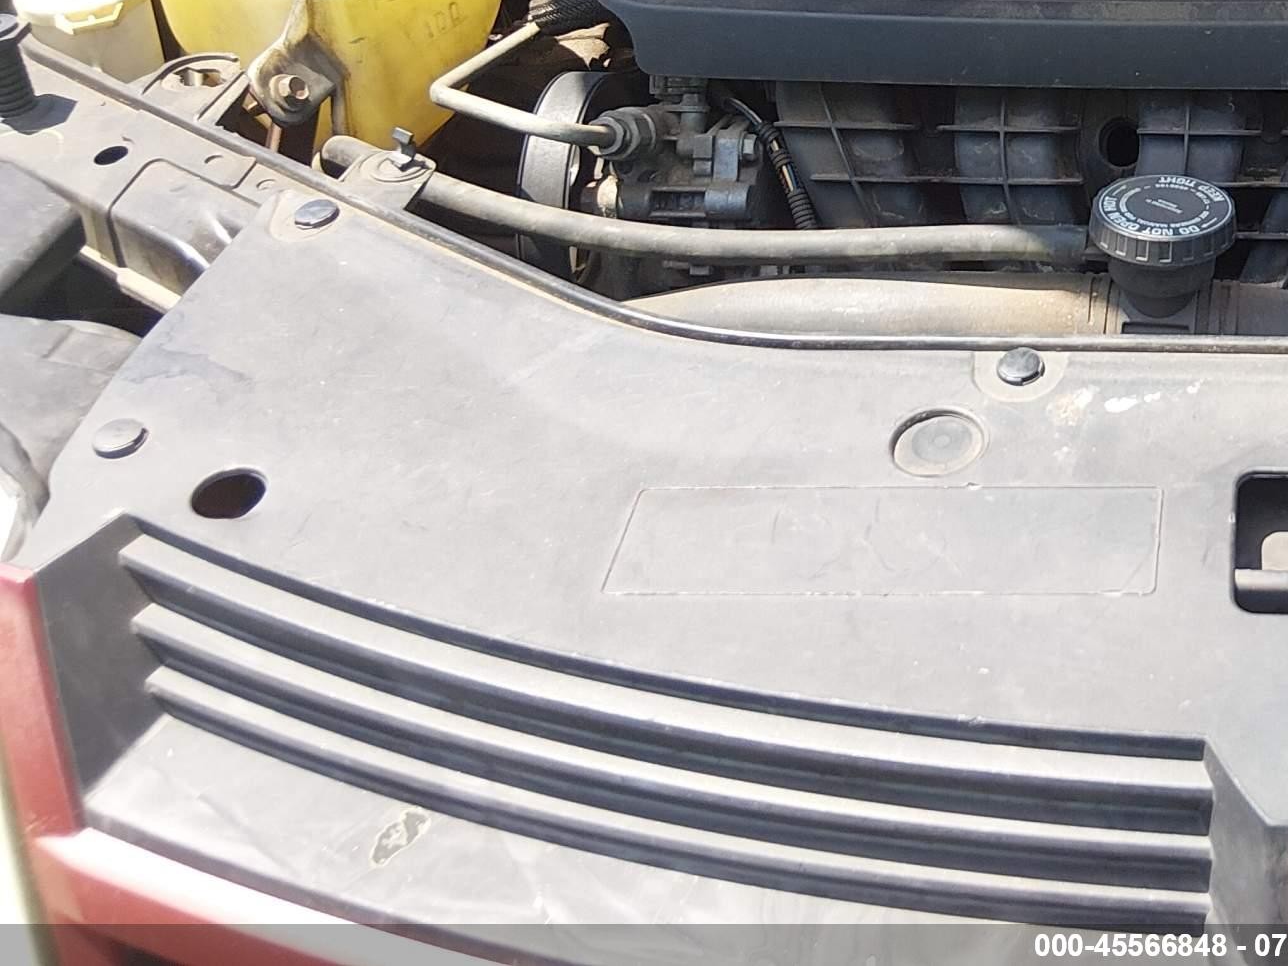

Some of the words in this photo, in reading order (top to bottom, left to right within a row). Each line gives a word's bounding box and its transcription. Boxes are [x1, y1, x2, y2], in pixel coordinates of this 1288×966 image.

[1158, 176, 1197, 188] TIGHT
[1197, 185, 1225, 202] KEEP
[1103, 196, 1118, 212] HOT
[1107, 212, 1141, 231] OPEN
[1141, 226, 1174, 236] NOT
[1178, 225, 1201, 235] DO
